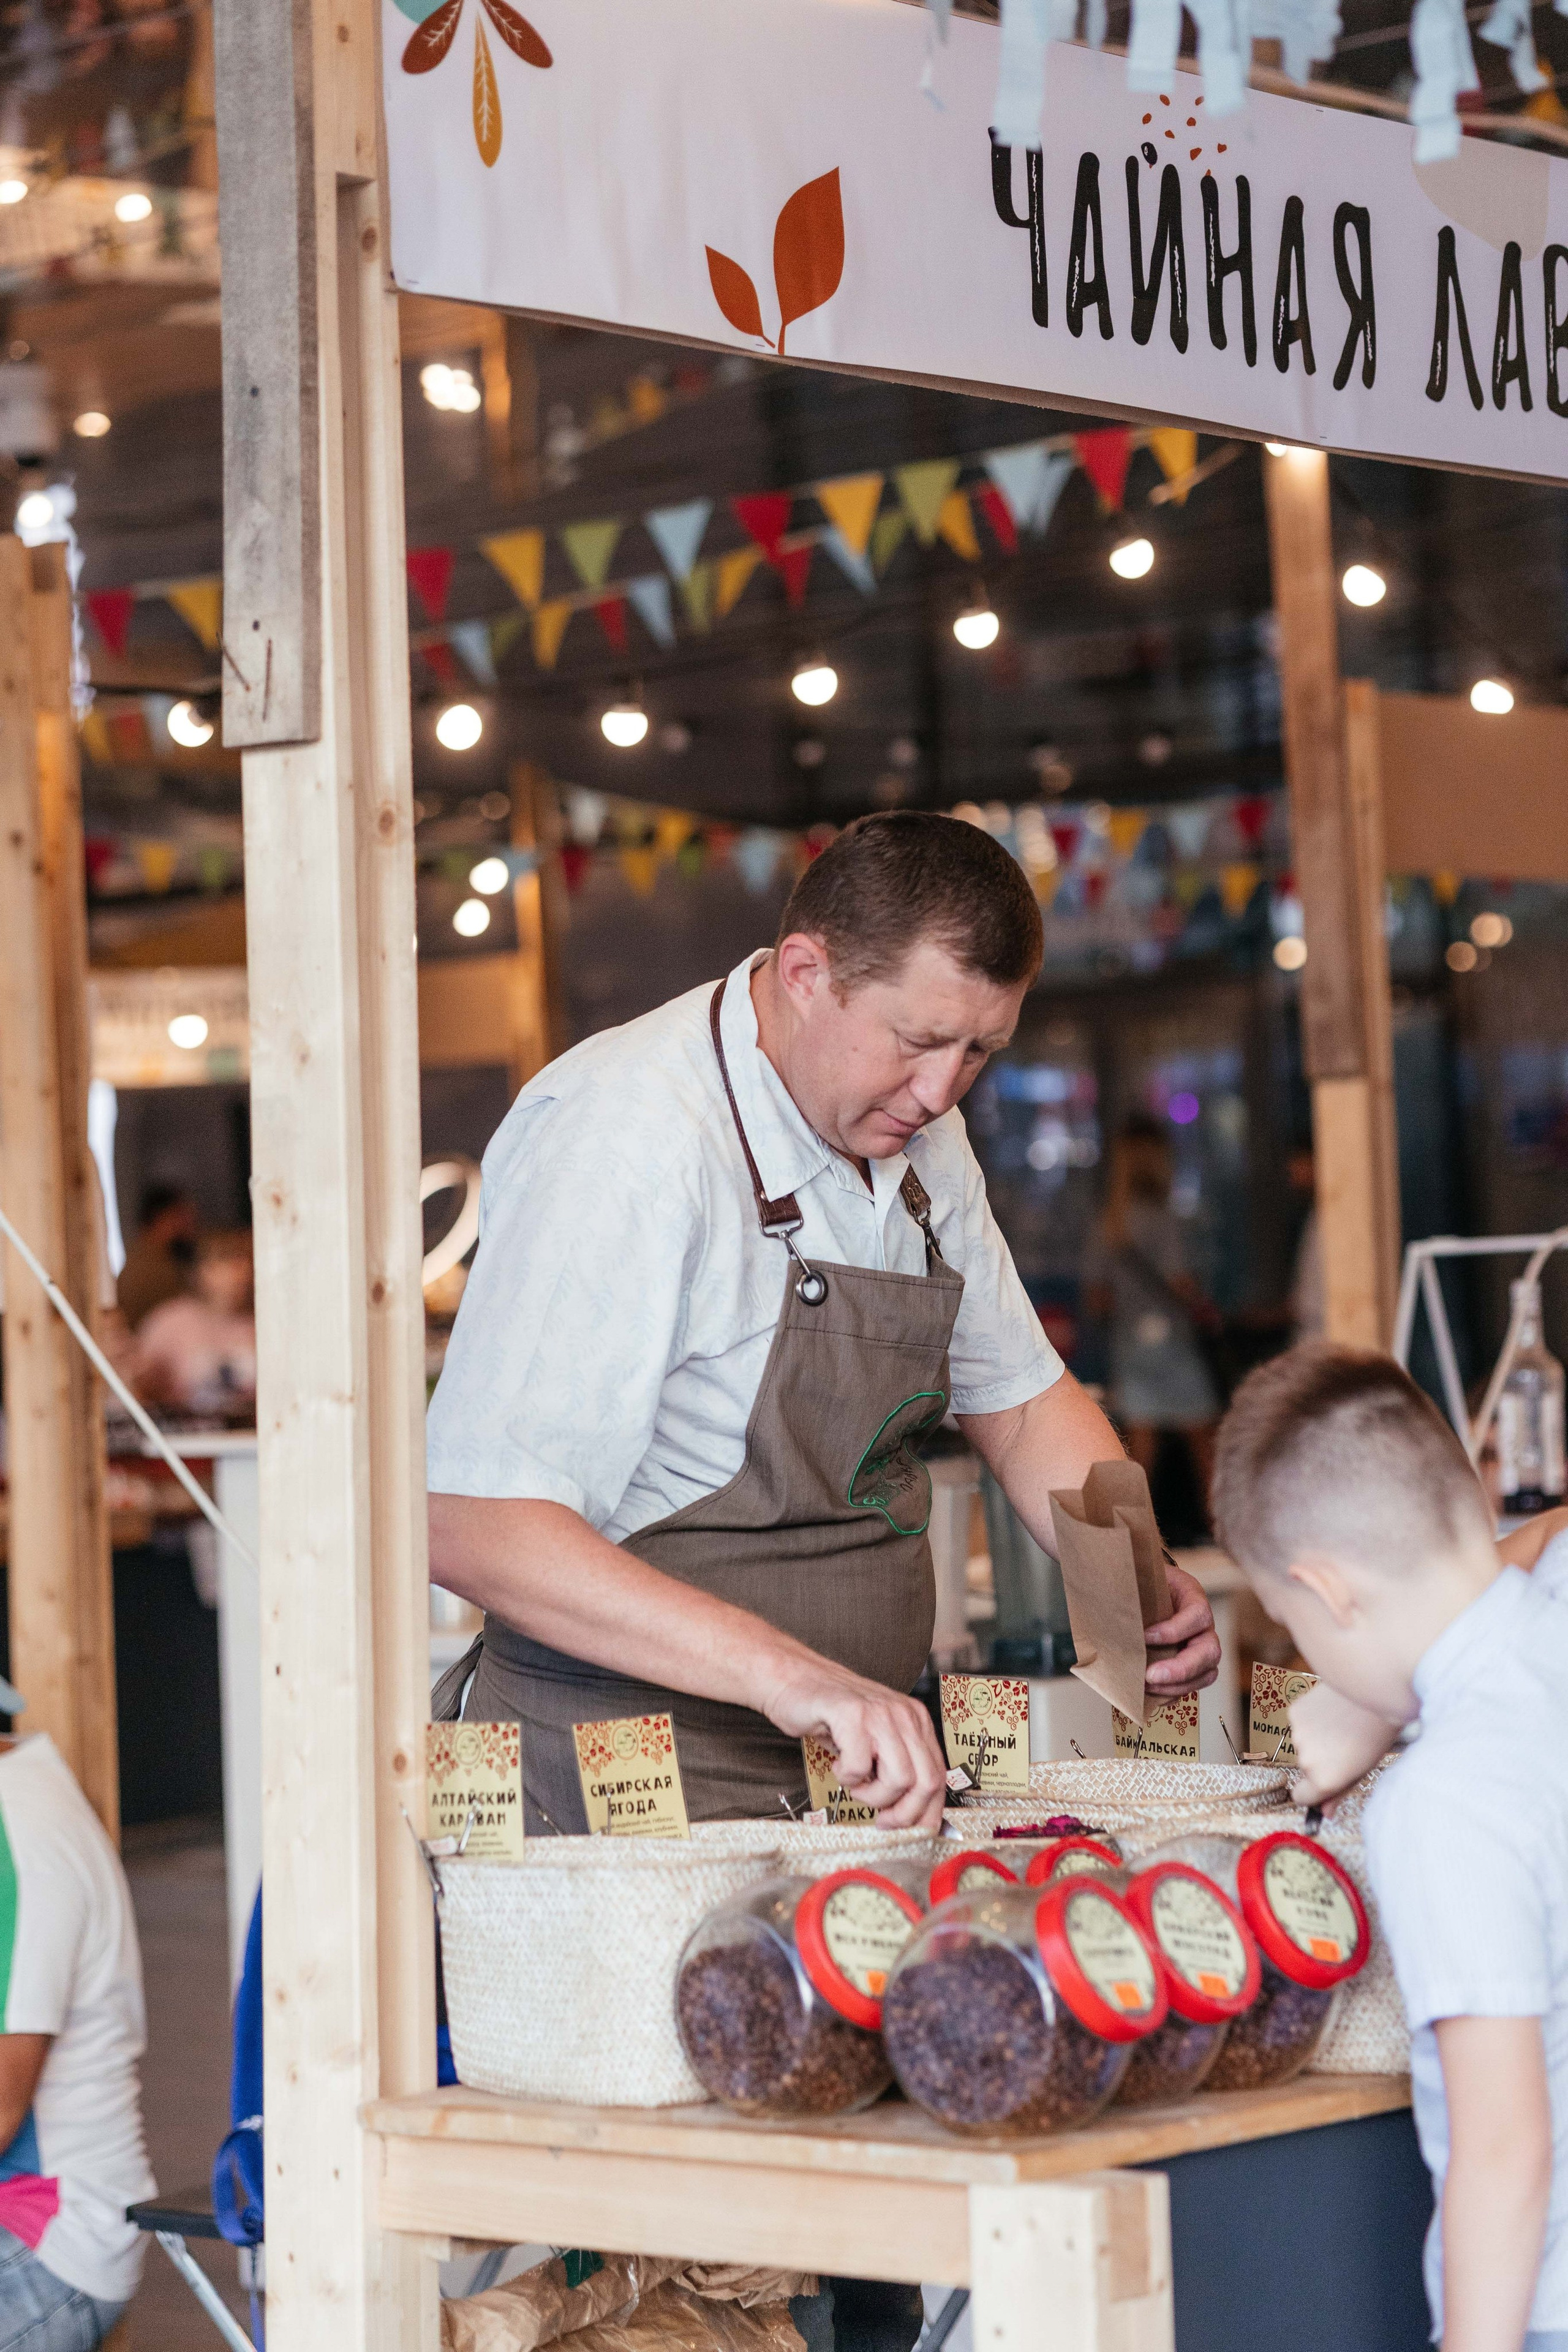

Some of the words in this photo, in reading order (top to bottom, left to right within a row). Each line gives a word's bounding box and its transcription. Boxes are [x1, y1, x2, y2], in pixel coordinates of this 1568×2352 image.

[988, 126, 1377, 391] ЧАЙНАЯ
[1115, 1735, 1196, 1757] БАЙКАЛЬСКАЯ
[432, 1787, 516, 1807] АЛТАЙСКИЙ
[590, 1776, 673, 1798] СИБИРСКАЯ
[610, 1798, 657, 1816] ЯГОДА
[439, 1811, 506, 1827] КАРВАН
